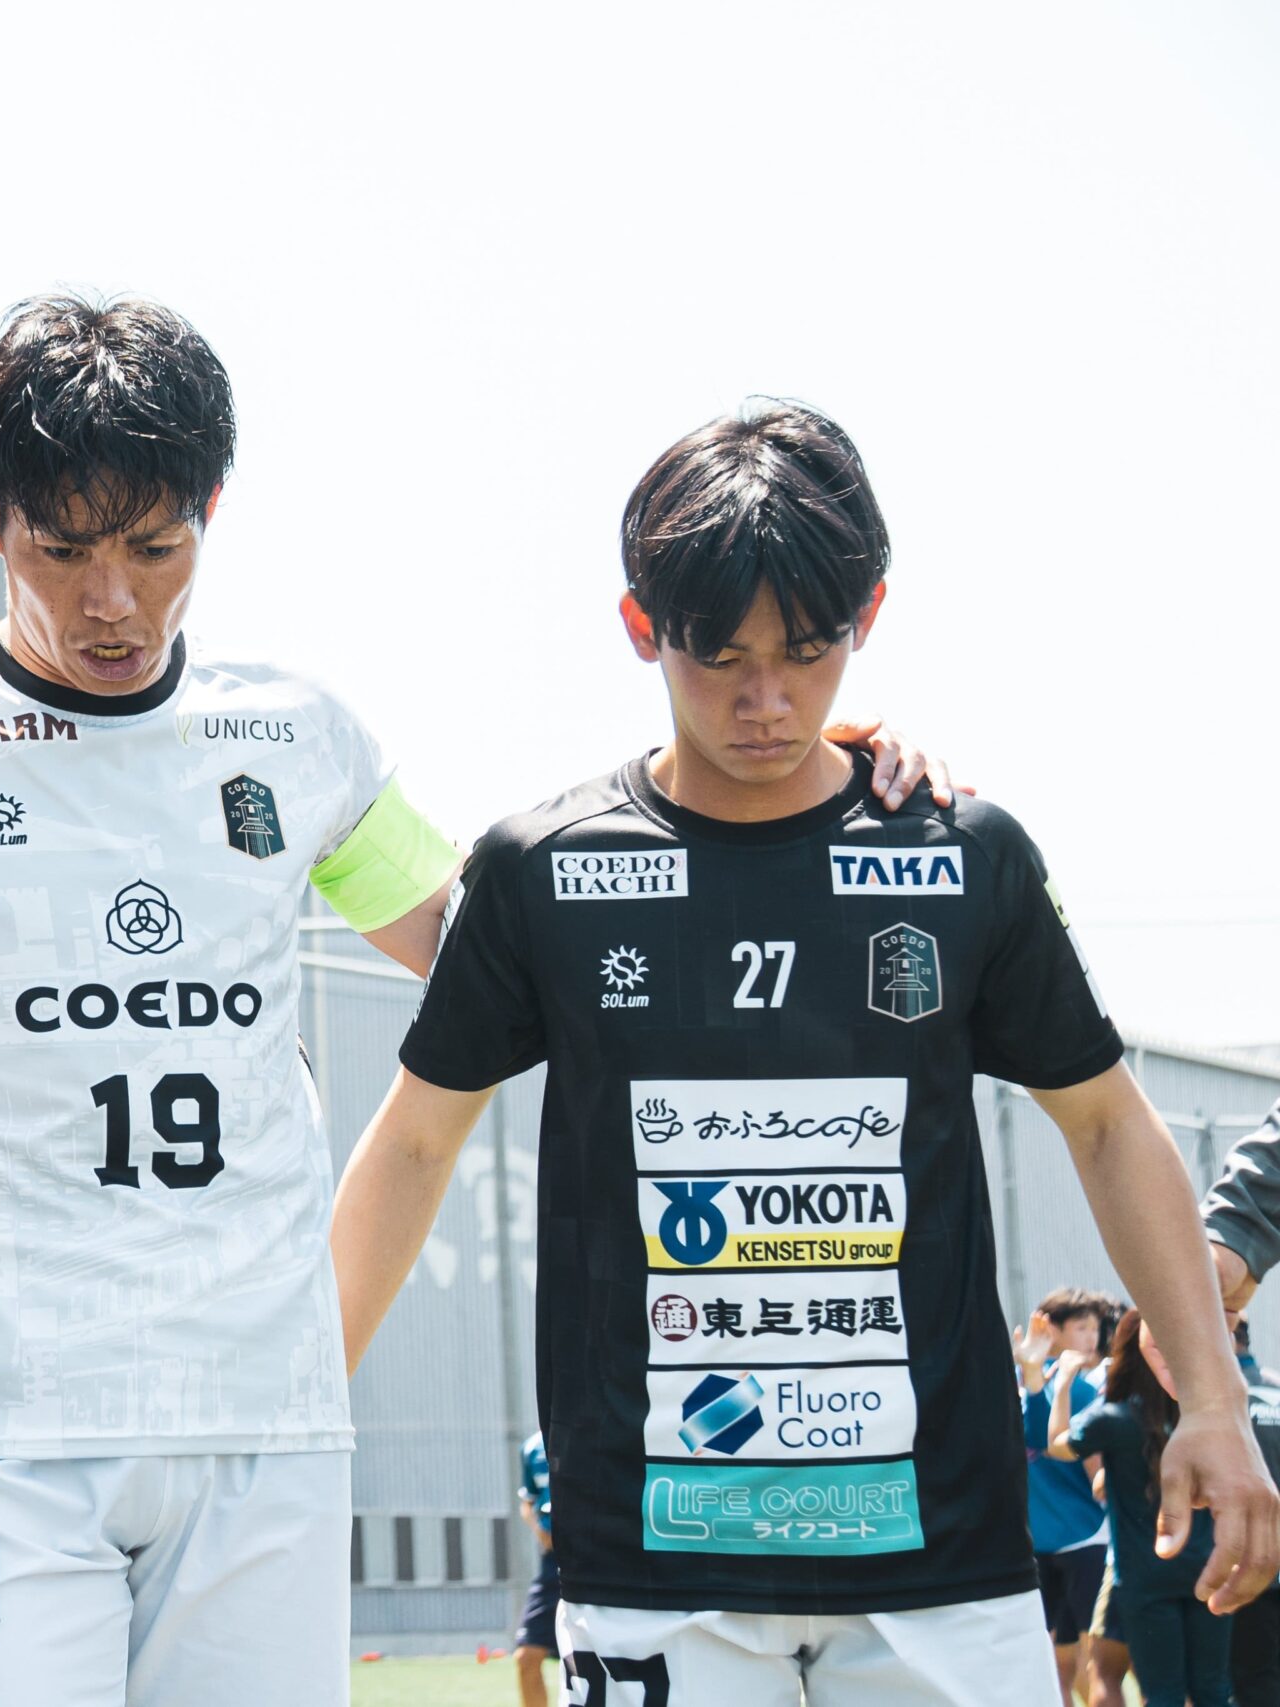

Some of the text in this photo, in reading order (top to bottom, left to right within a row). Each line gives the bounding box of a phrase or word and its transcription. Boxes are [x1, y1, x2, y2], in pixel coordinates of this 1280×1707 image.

[204, 717, 295, 743] UNICUS
[227, 782, 266, 797] COEDO
[556, 855, 676, 875] COEDO
[832, 855, 962, 886] TAKA
[558, 874, 677, 894] HACHI
[880, 934, 927, 949] COEDO
[731, 941, 796, 1009] 27
[15, 979, 263, 1033] COEDO
[600, 993, 649, 1009] SOLum
[90, 1073, 225, 1190] 19
[735, 1183, 894, 1225] YOKOTA
[736, 1240, 894, 1262] KENSETSU group
[777, 1380, 882, 1414] Fluoro
[777, 1417, 864, 1449] Coat
[648, 1477, 752, 1540] LIFE
[752, 1519, 878, 1539] ライフコート
